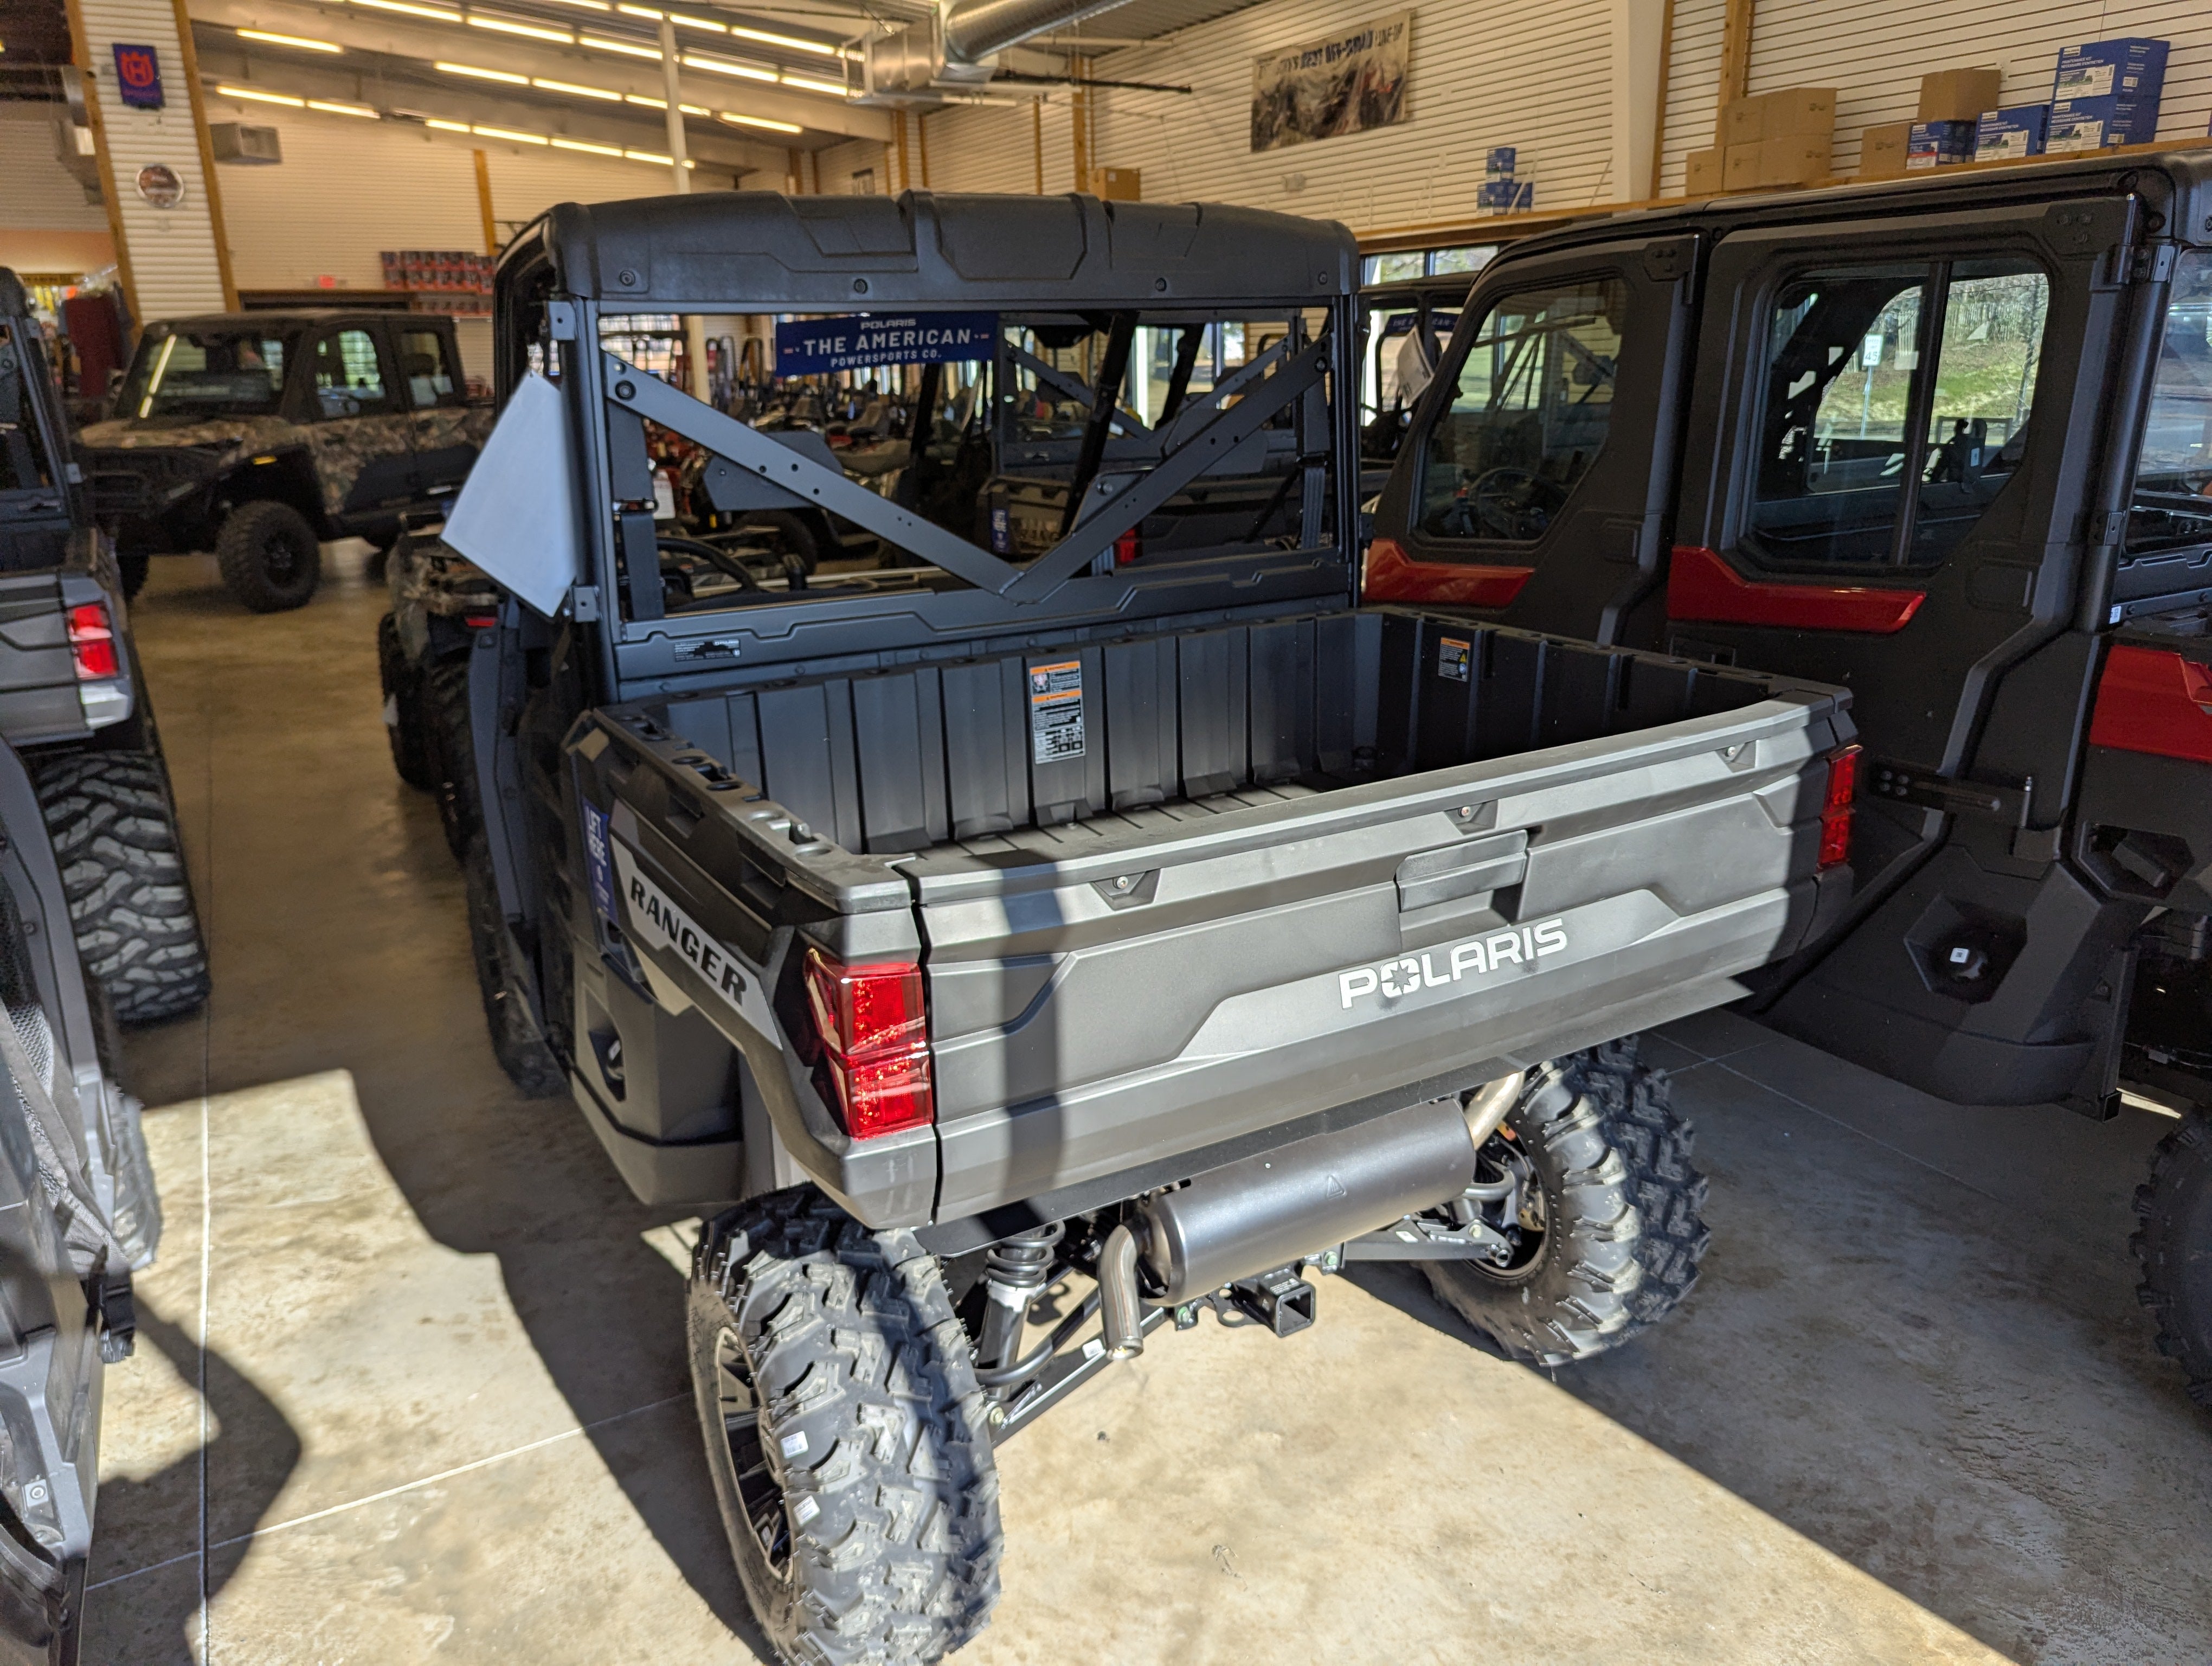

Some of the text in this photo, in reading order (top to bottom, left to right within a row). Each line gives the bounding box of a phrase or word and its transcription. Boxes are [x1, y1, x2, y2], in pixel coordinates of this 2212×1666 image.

[860, 318, 917, 330] POLARIS
[803, 328, 971, 356] THE AMERICAN
[830, 348, 942, 368] POWERSPORTS CO.
[1865, 351, 1878, 362] 45
[630, 875, 748, 1007] RANGER
[1338, 917, 1568, 1010] POLARIS
